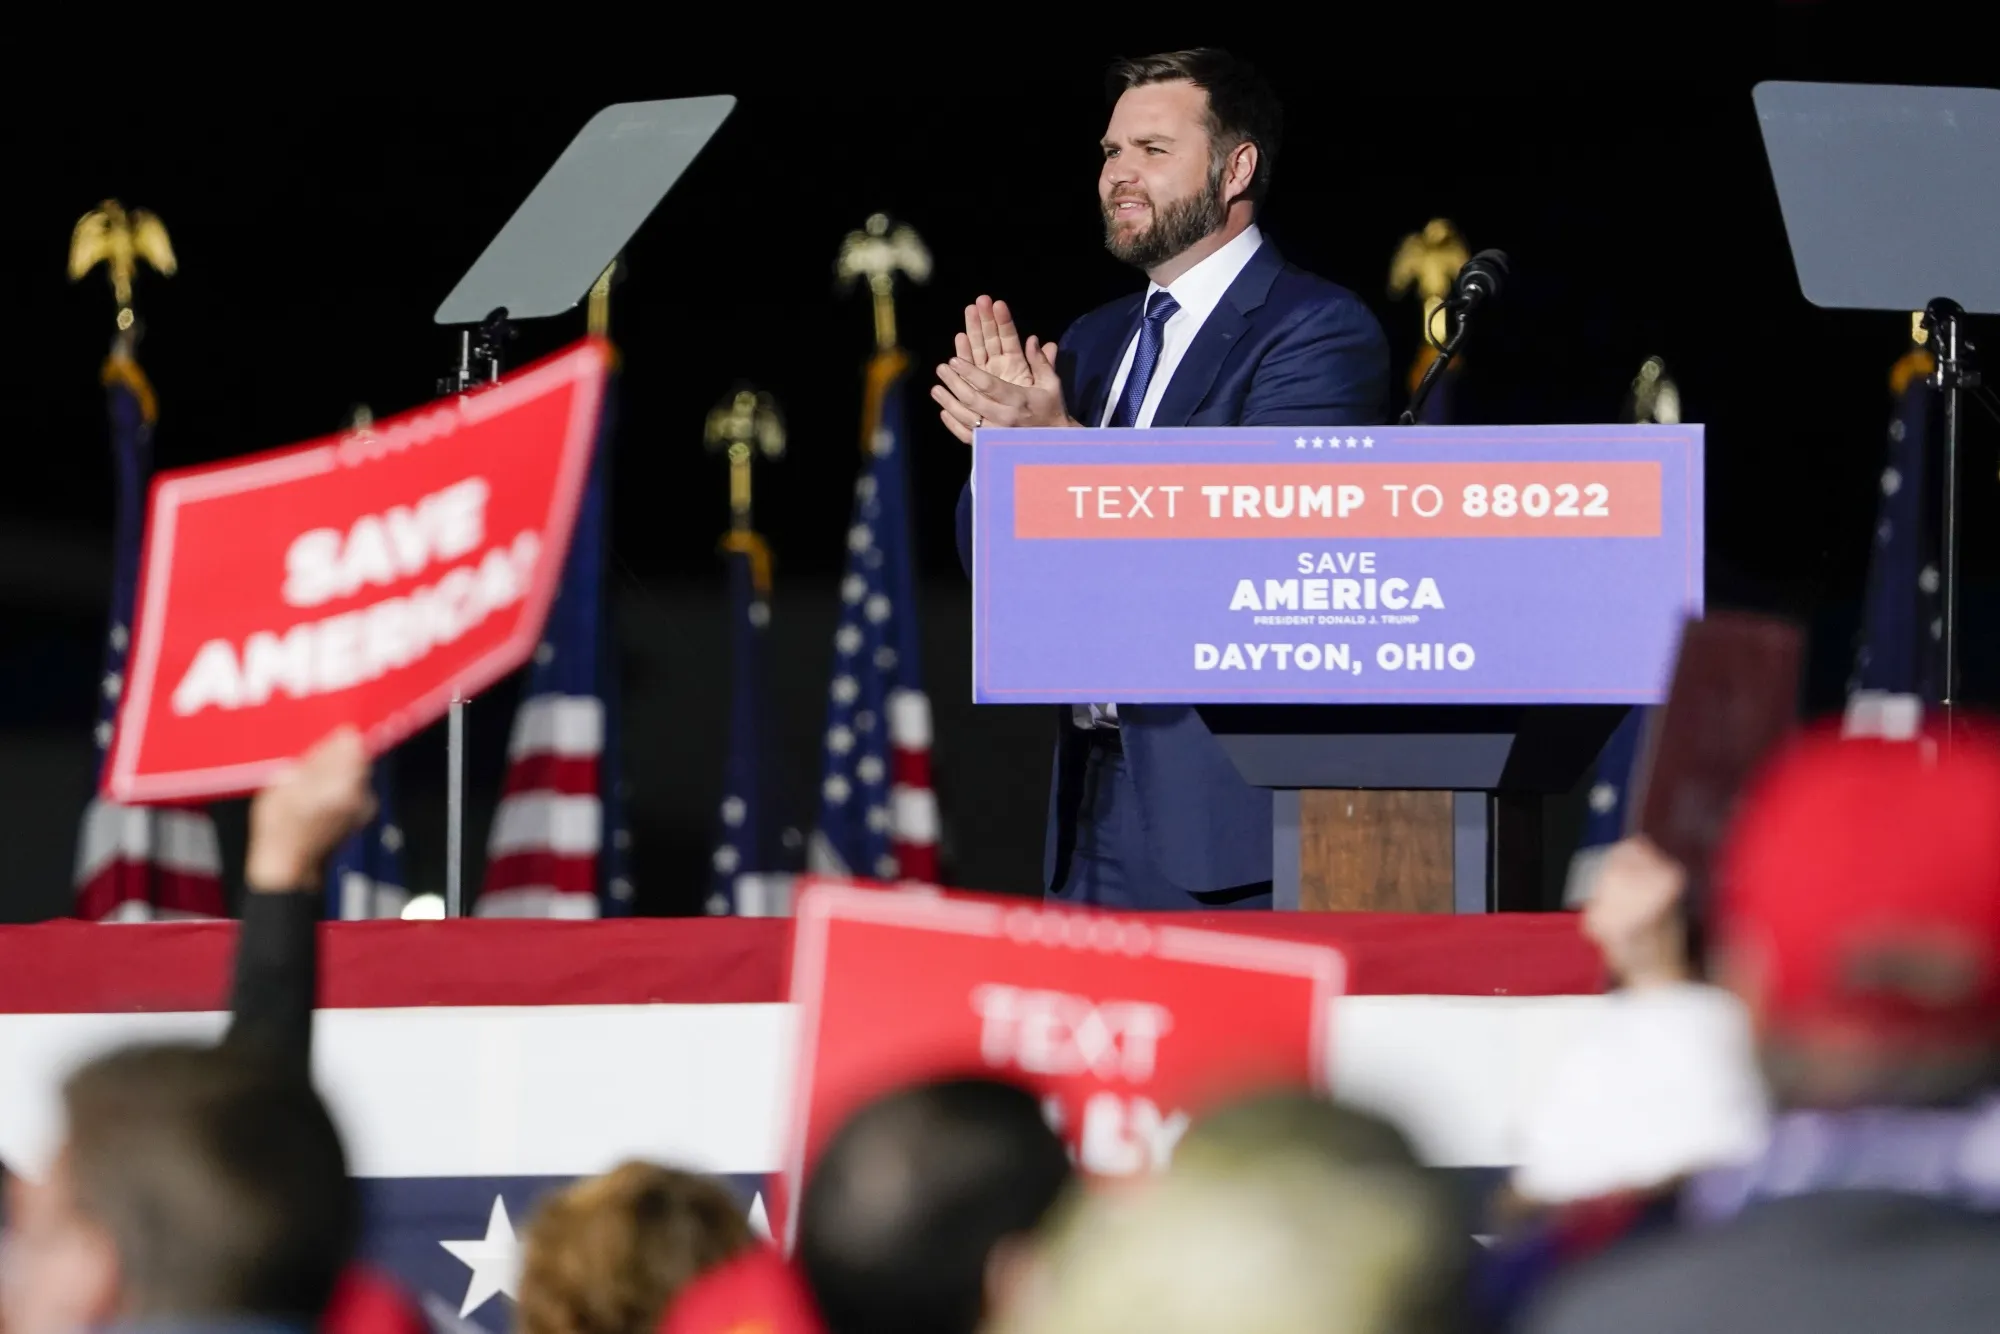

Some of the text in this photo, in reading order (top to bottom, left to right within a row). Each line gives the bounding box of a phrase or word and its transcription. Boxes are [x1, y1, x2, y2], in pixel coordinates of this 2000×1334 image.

[1067, 482, 1610, 519] TEXT TRUMP TO 88022
[283, 475, 490, 608] SAVE
[1297, 551, 1376, 575] SAVE
[1229, 577, 1445, 611] AMERICA
[1253, 614, 1420, 626] PRESIDENT DONALD J. TRUMP
[1194, 642, 1476, 676] DAYTON, OHIO
[969, 983, 1173, 1084] TEXT
